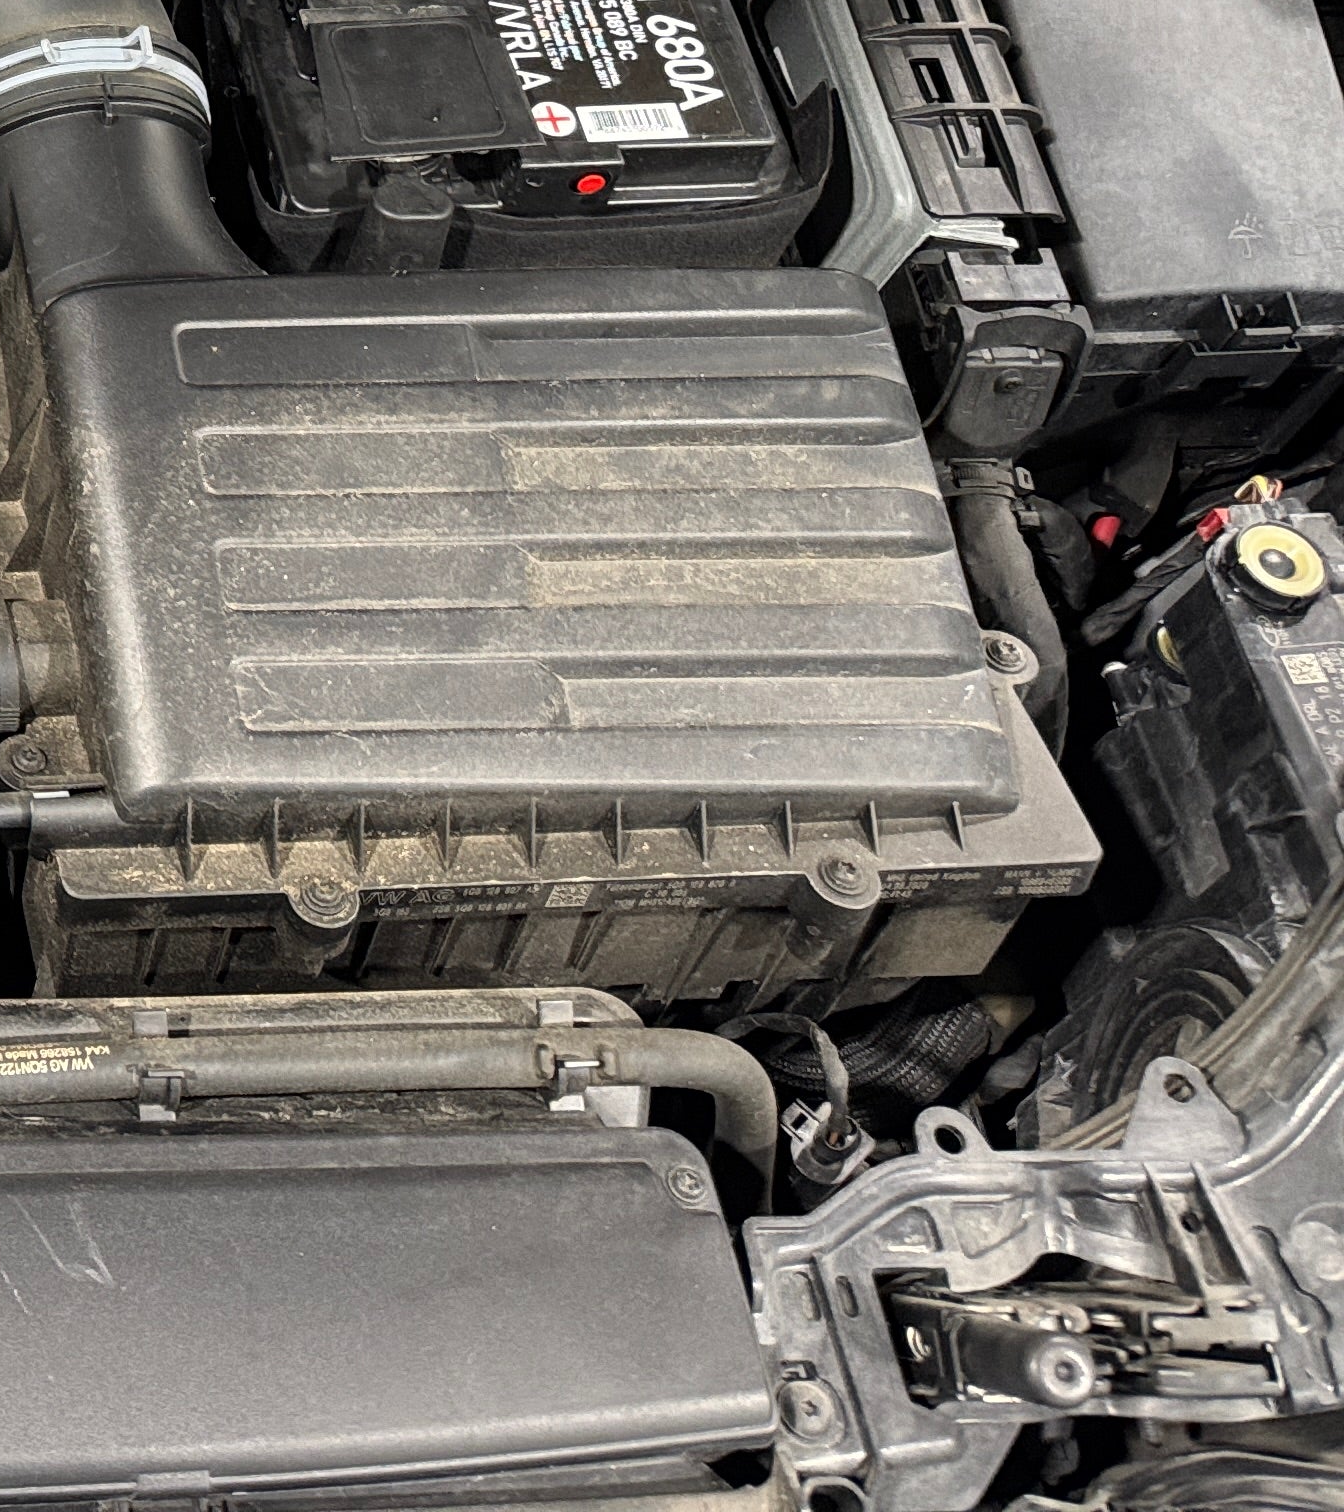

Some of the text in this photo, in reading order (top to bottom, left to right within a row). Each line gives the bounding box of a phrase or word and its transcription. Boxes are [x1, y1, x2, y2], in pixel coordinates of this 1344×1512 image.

[602, 10, 628, 37] 089
[628, 24, 647, 43] DIN
[613, 39, 638, 61] BC
[591, 58, 604, 68] VA
[643, 11, 728, 111] 680A
[1300, 698, 1323, 721] DRL
[359, 891, 405, 905] VW
[5, 1049, 37, 1060] Made
[49, 1059, 68, 1072] AG
[71, 1057, 94, 1070] VW
